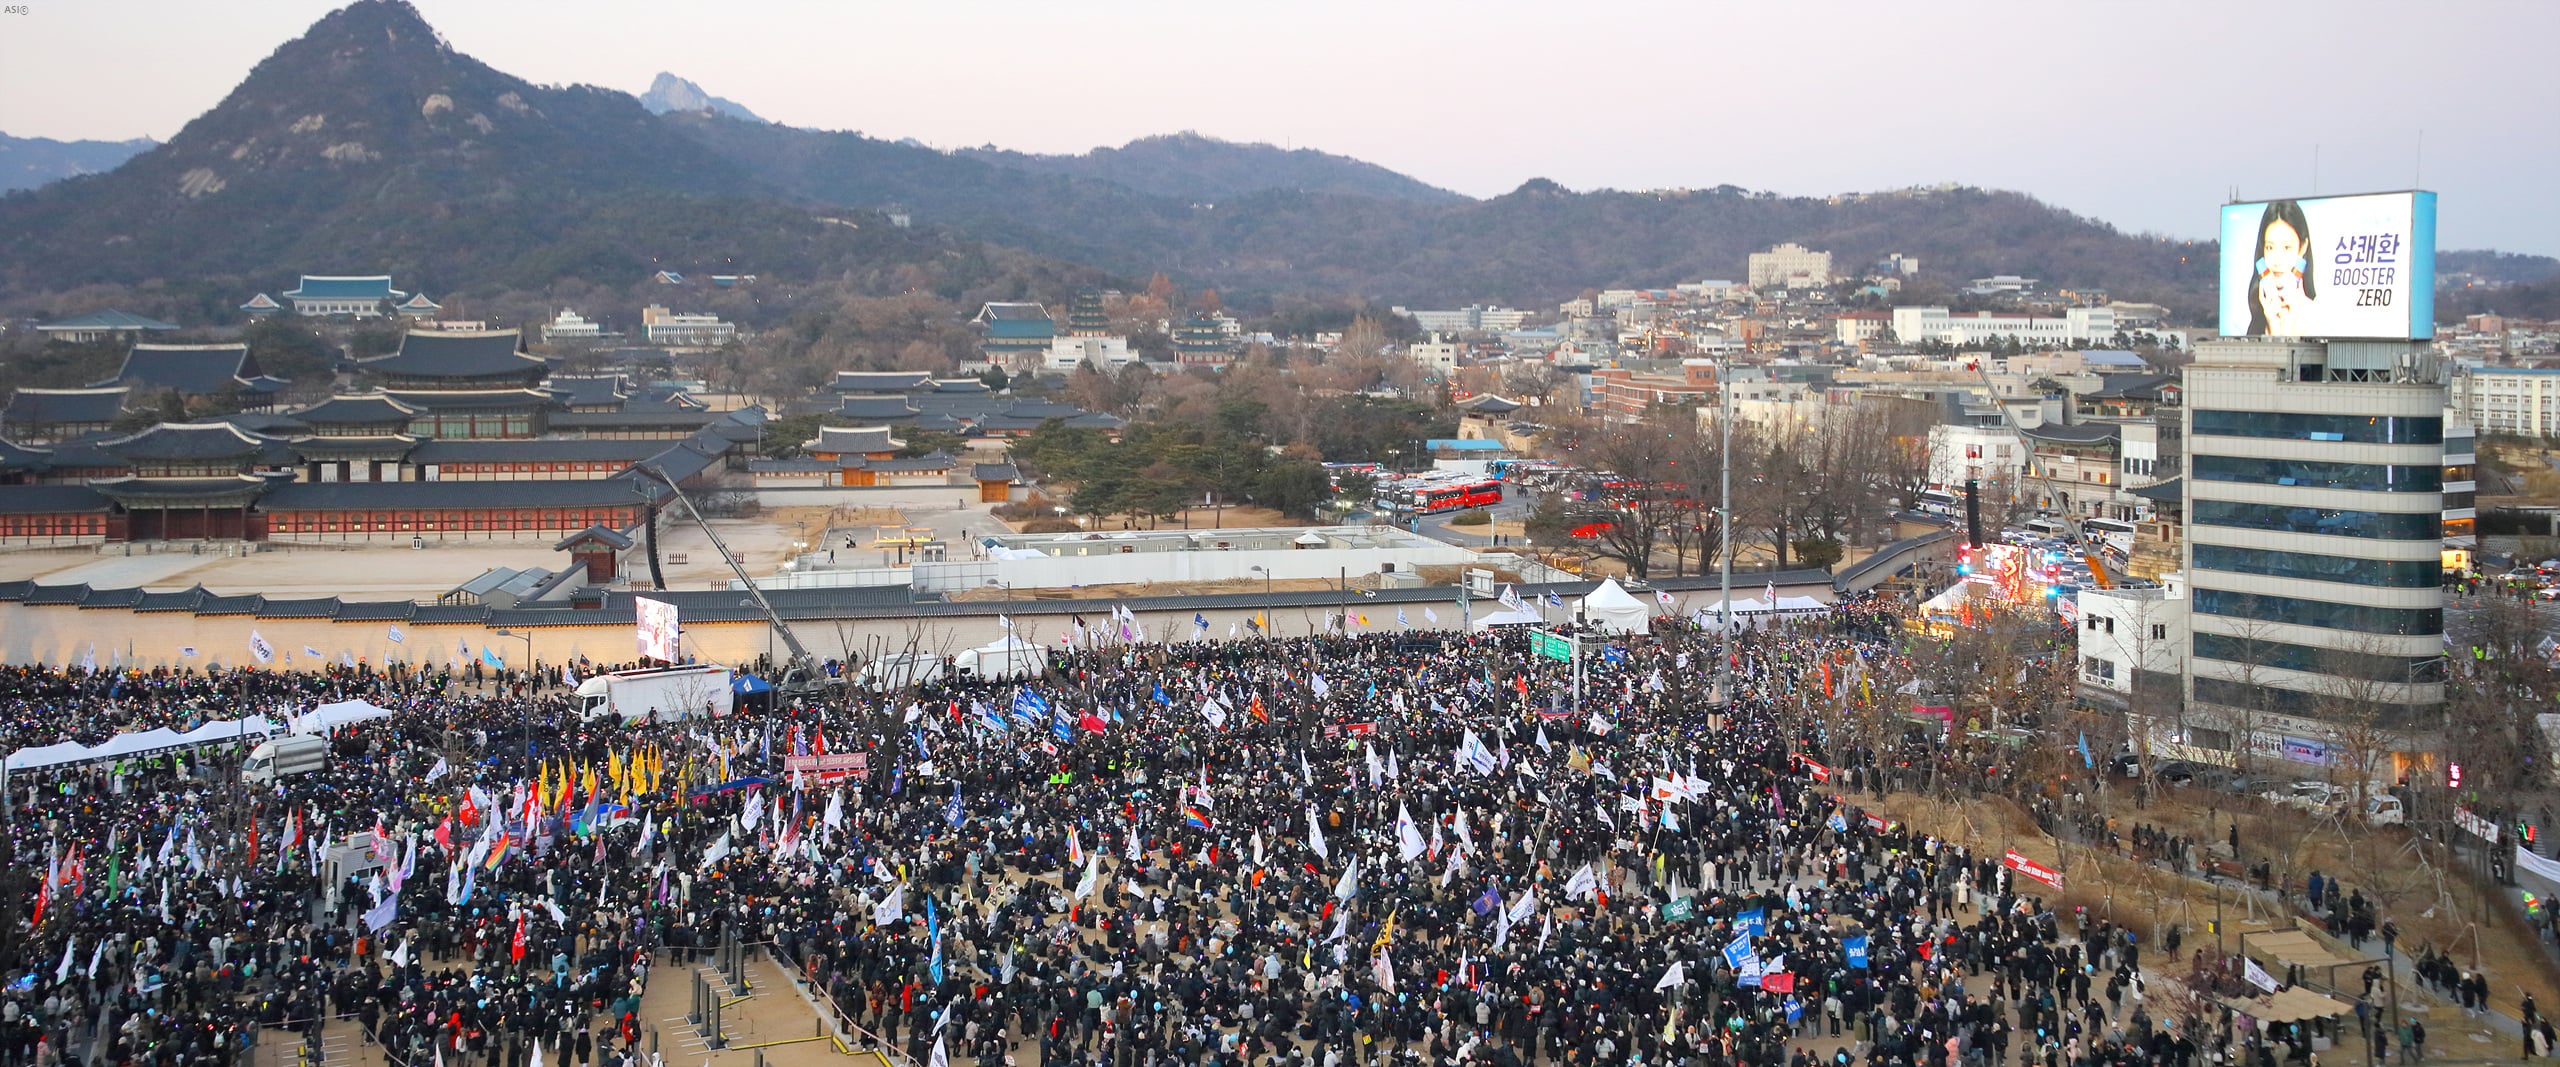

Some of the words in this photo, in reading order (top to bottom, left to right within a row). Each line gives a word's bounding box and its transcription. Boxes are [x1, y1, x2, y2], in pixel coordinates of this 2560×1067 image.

[2334, 232, 2400, 264] 상쾌환
[2333, 267, 2395, 286] BOOSTER
[2356, 288, 2393, 307] ZERO
